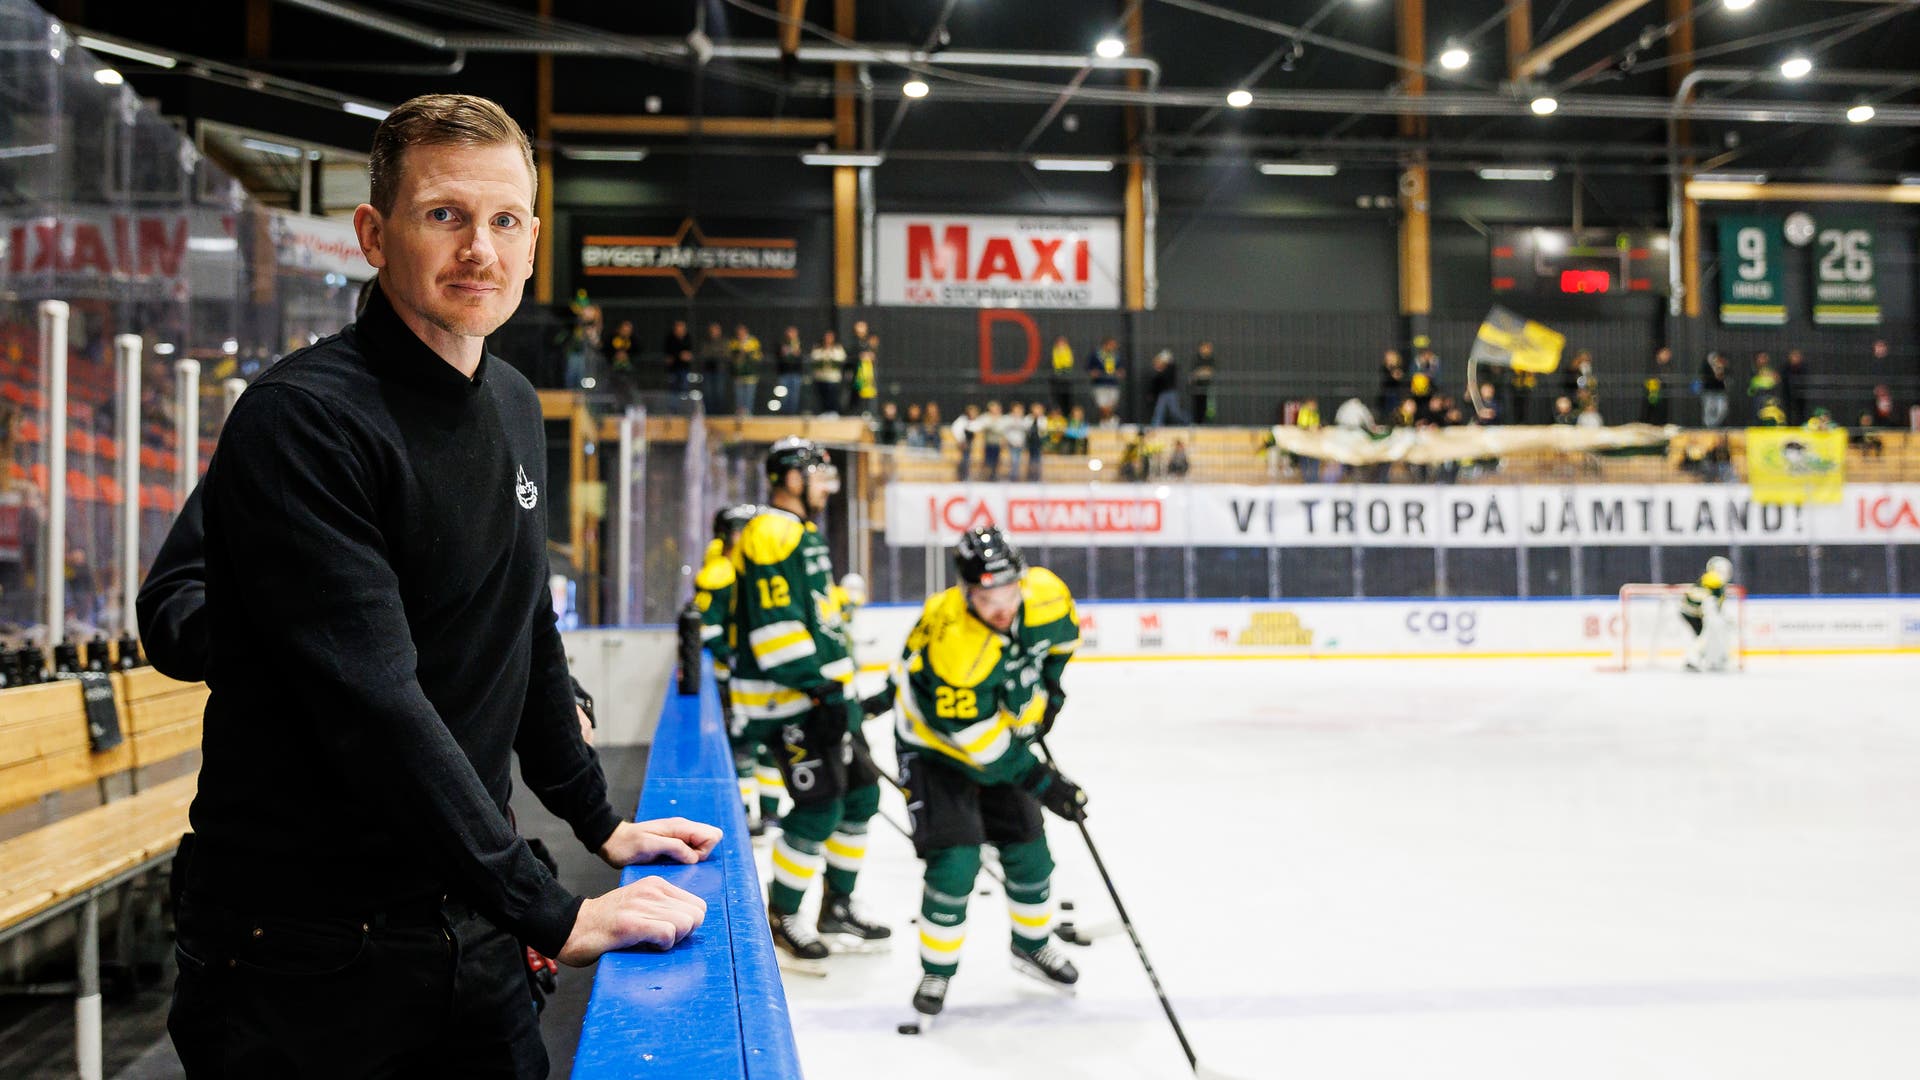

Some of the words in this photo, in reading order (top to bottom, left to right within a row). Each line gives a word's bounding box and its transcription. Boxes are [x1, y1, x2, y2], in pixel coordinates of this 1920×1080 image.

[907, 225, 1088, 282] MAXI
[1737, 227, 1767, 281] 9
[1819, 229, 1873, 282] 26
[979, 308, 1042, 385] D
[929, 496, 996, 532] ICA
[1011, 502, 1158, 531] KVANTUM
[1231, 500, 1274, 533] VI
[1301, 500, 1425, 533] TROR
[1453, 493, 1505, 534] PÅ
[1857, 498, 1920, 531] ICA
[756, 575, 792, 609] 12
[1405, 611, 1476, 645] cag
[935, 686, 978, 719] 22
